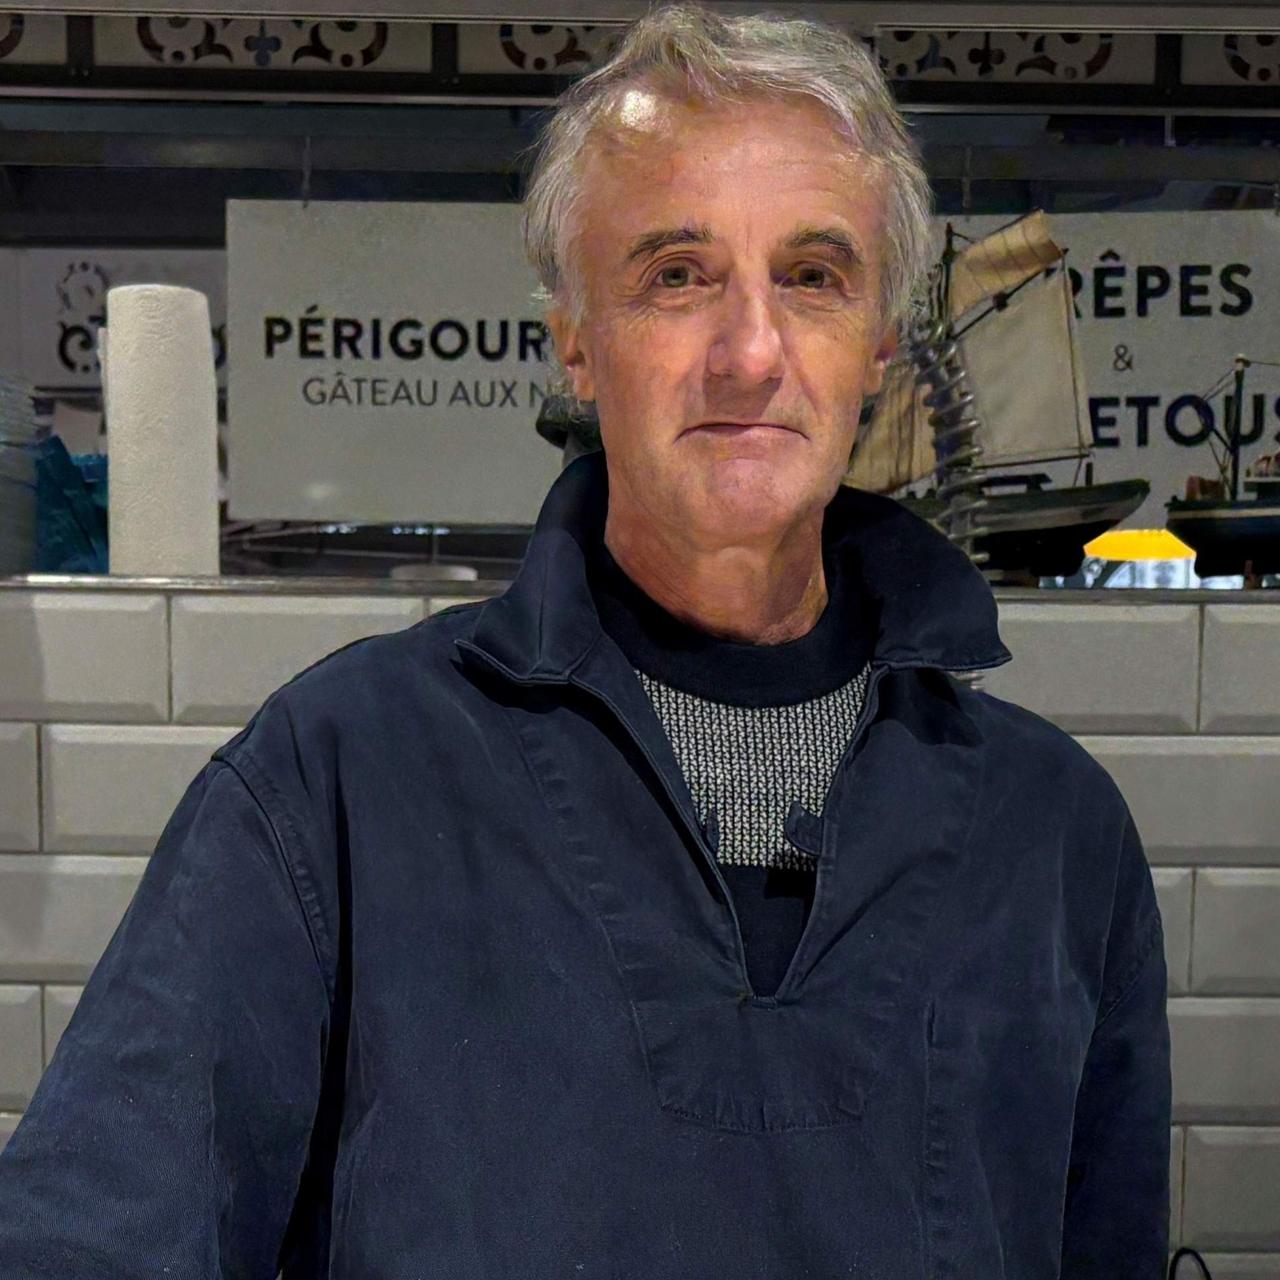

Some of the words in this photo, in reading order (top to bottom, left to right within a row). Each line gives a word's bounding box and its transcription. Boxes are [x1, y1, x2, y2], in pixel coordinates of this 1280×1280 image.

[1113, 343, 1134, 372] &
[301, 371, 438, 407] GÂTEAU
[448, 378, 521, 408] AUX
